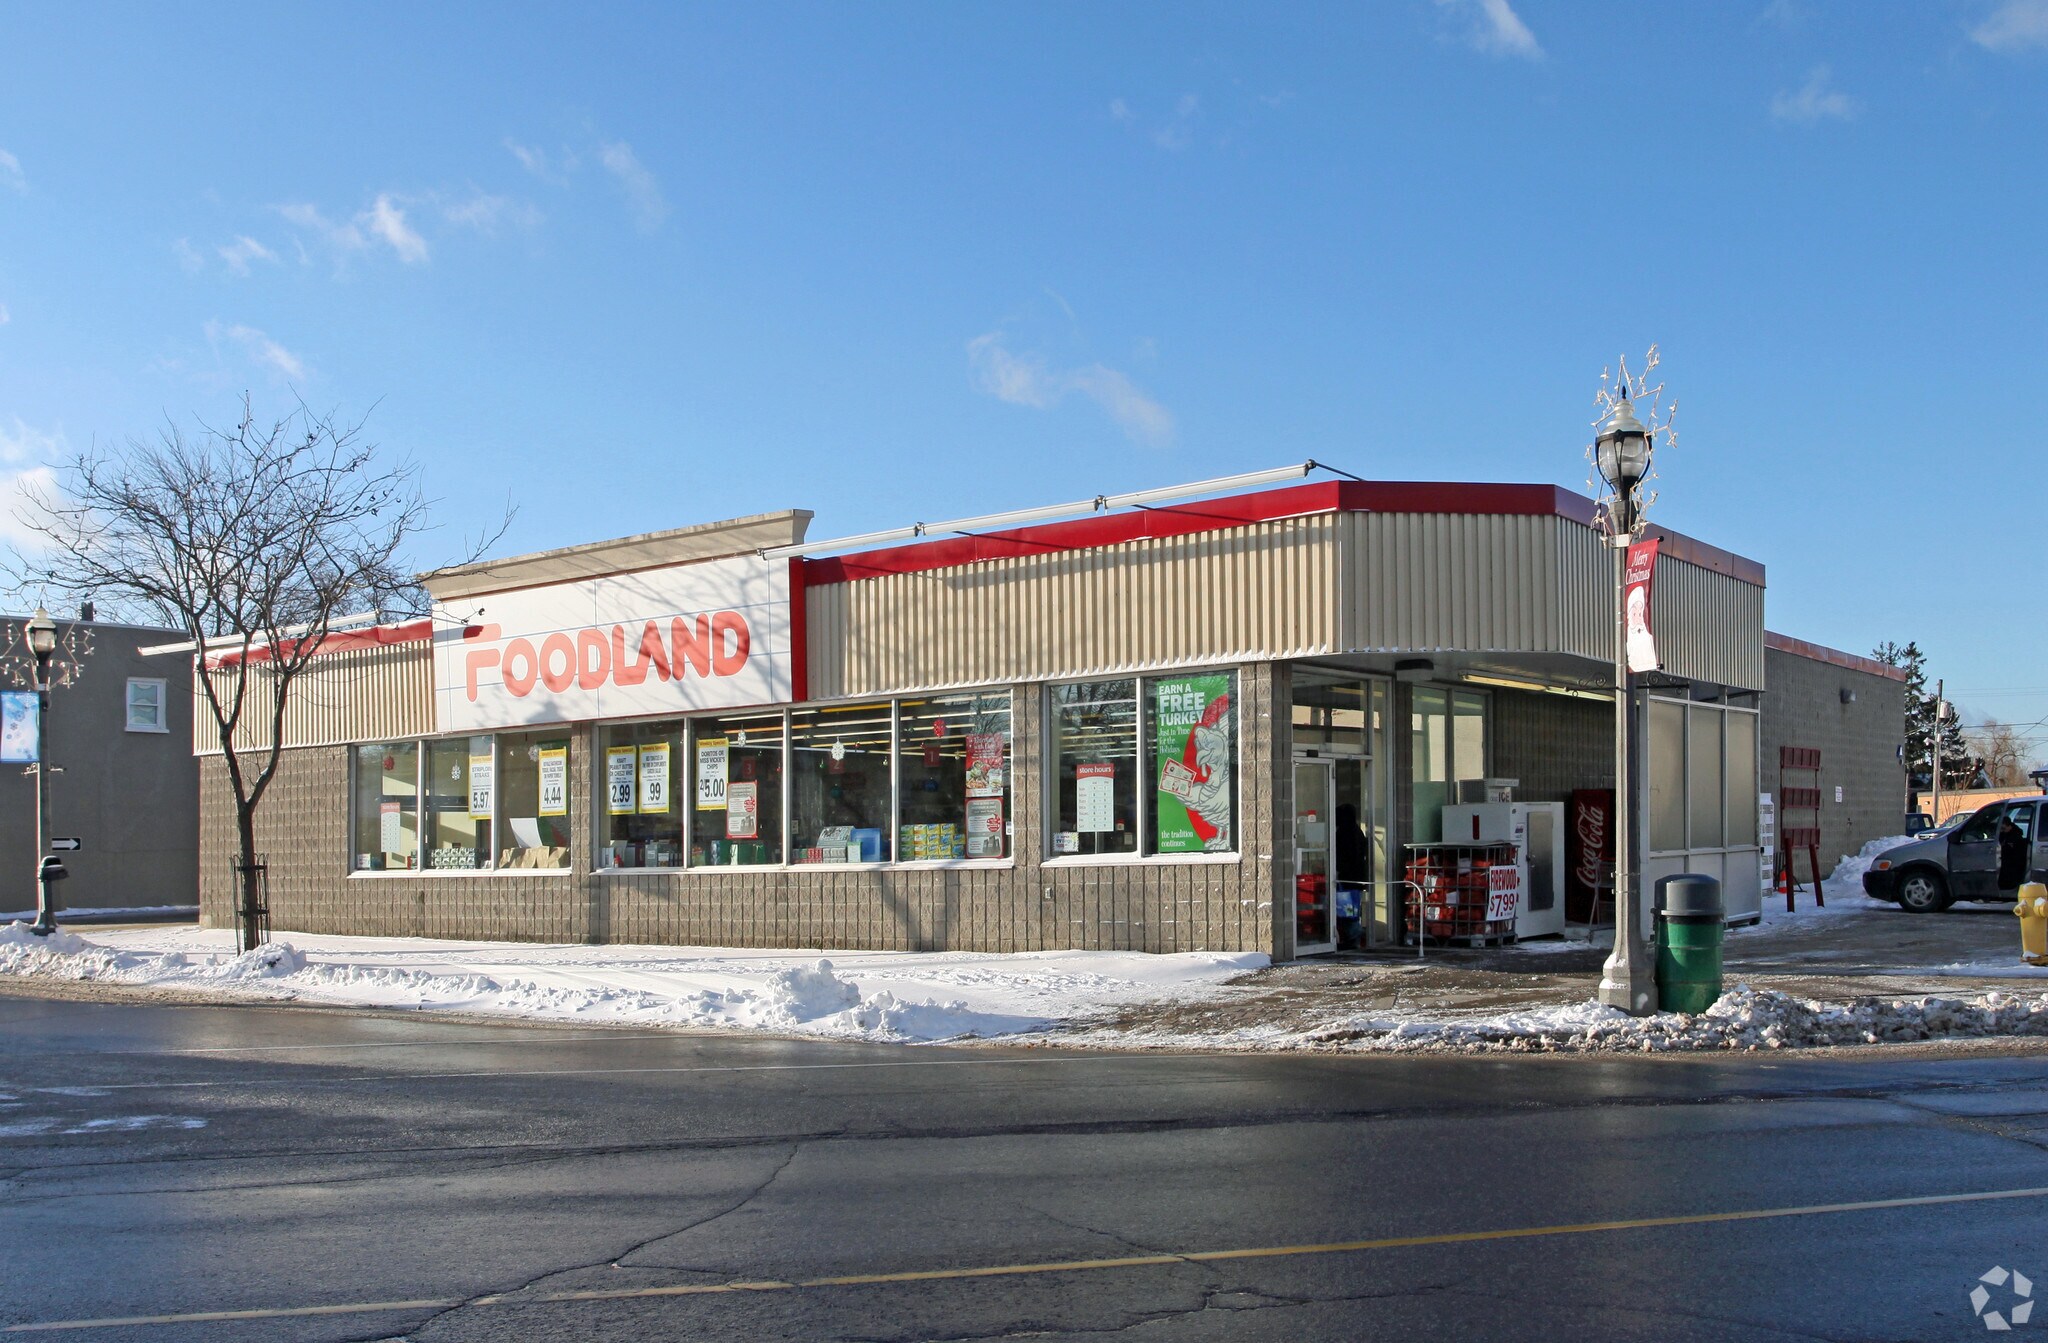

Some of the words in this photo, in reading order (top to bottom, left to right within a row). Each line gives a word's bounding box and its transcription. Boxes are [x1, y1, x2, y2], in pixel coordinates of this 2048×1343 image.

[1631, 550, 1649, 567] Merry
[1626, 568, 1650, 585] Christmas
[463, 610, 751, 702] FOODLAND
[1159, 684, 1183, 695] EARN
[1185, 683, 1192, 692] A
[1160, 692, 1205, 713] FREE
[1159, 710, 1204, 726] TURKEY
[474, 791, 489, 808] 5.97
[544, 786, 561, 804] 4.44
[612, 784, 630, 802] 2.99
[648, 782, 661, 801] .99
[1498, 791, 1510, 802] ICE
[1161, 830, 1170, 838] the
[1171, 829, 1194, 838] tradition
[1161, 840, 1186, 848] continues
[1576, 802, 1604, 889] Coca-Cola
[1490, 868, 1516, 891] FIREWOOD
[1490, 893, 1515, 917] $7.99
